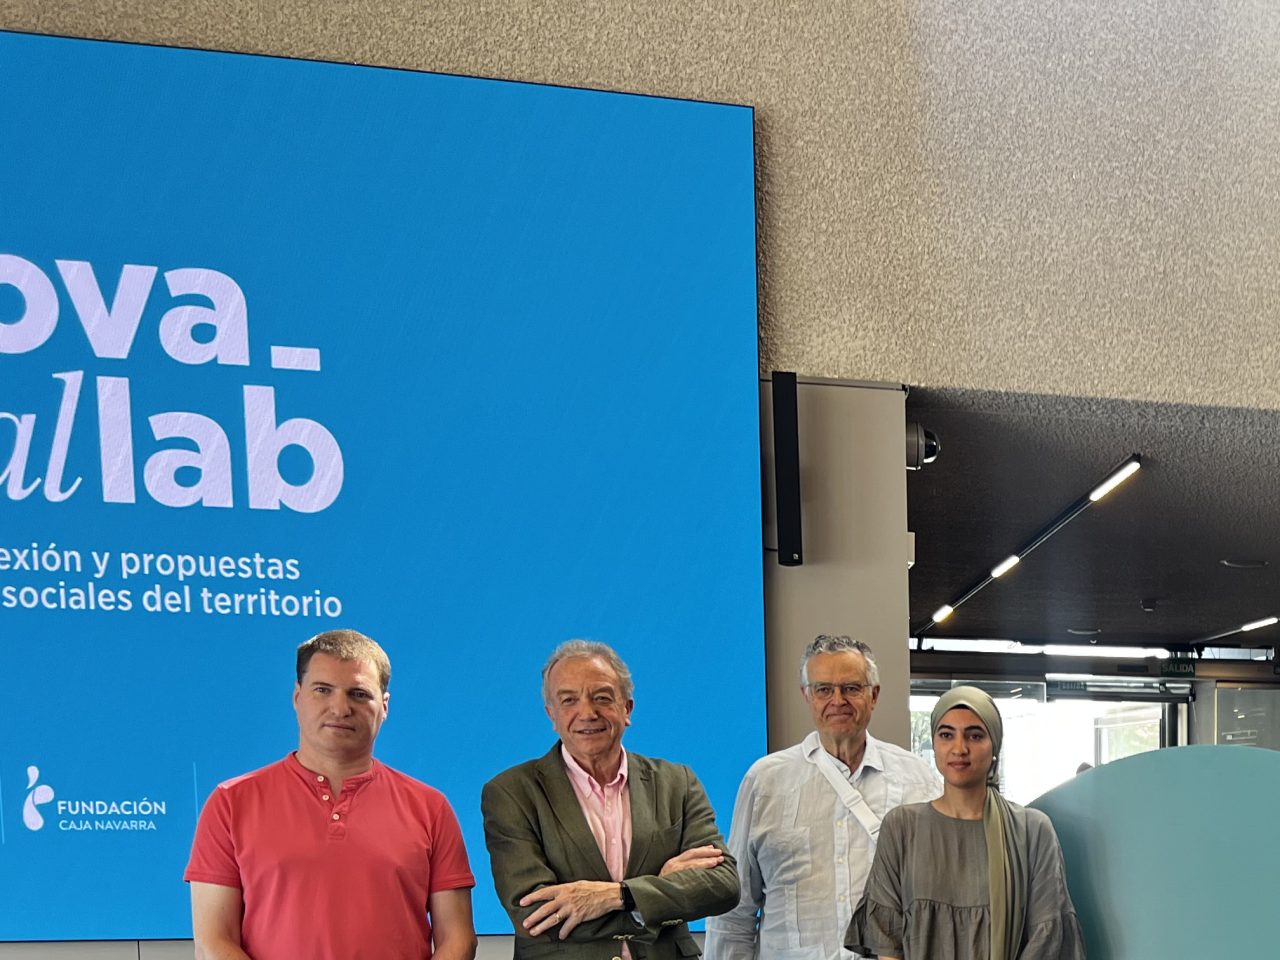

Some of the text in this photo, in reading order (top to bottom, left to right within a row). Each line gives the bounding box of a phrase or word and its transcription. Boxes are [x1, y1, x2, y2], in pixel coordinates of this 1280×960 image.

[96, 375, 345, 514] lab
[91, 550, 110, 579] y
[121, 551, 301, 582] propuestas
[2, 580, 343, 618] sociales del territorio
[1161, 662, 1195, 673] SALIDA
[57, 797, 167, 816] FUNDACIÓN
[58, 819, 157, 832] CAJA NAVARRA
